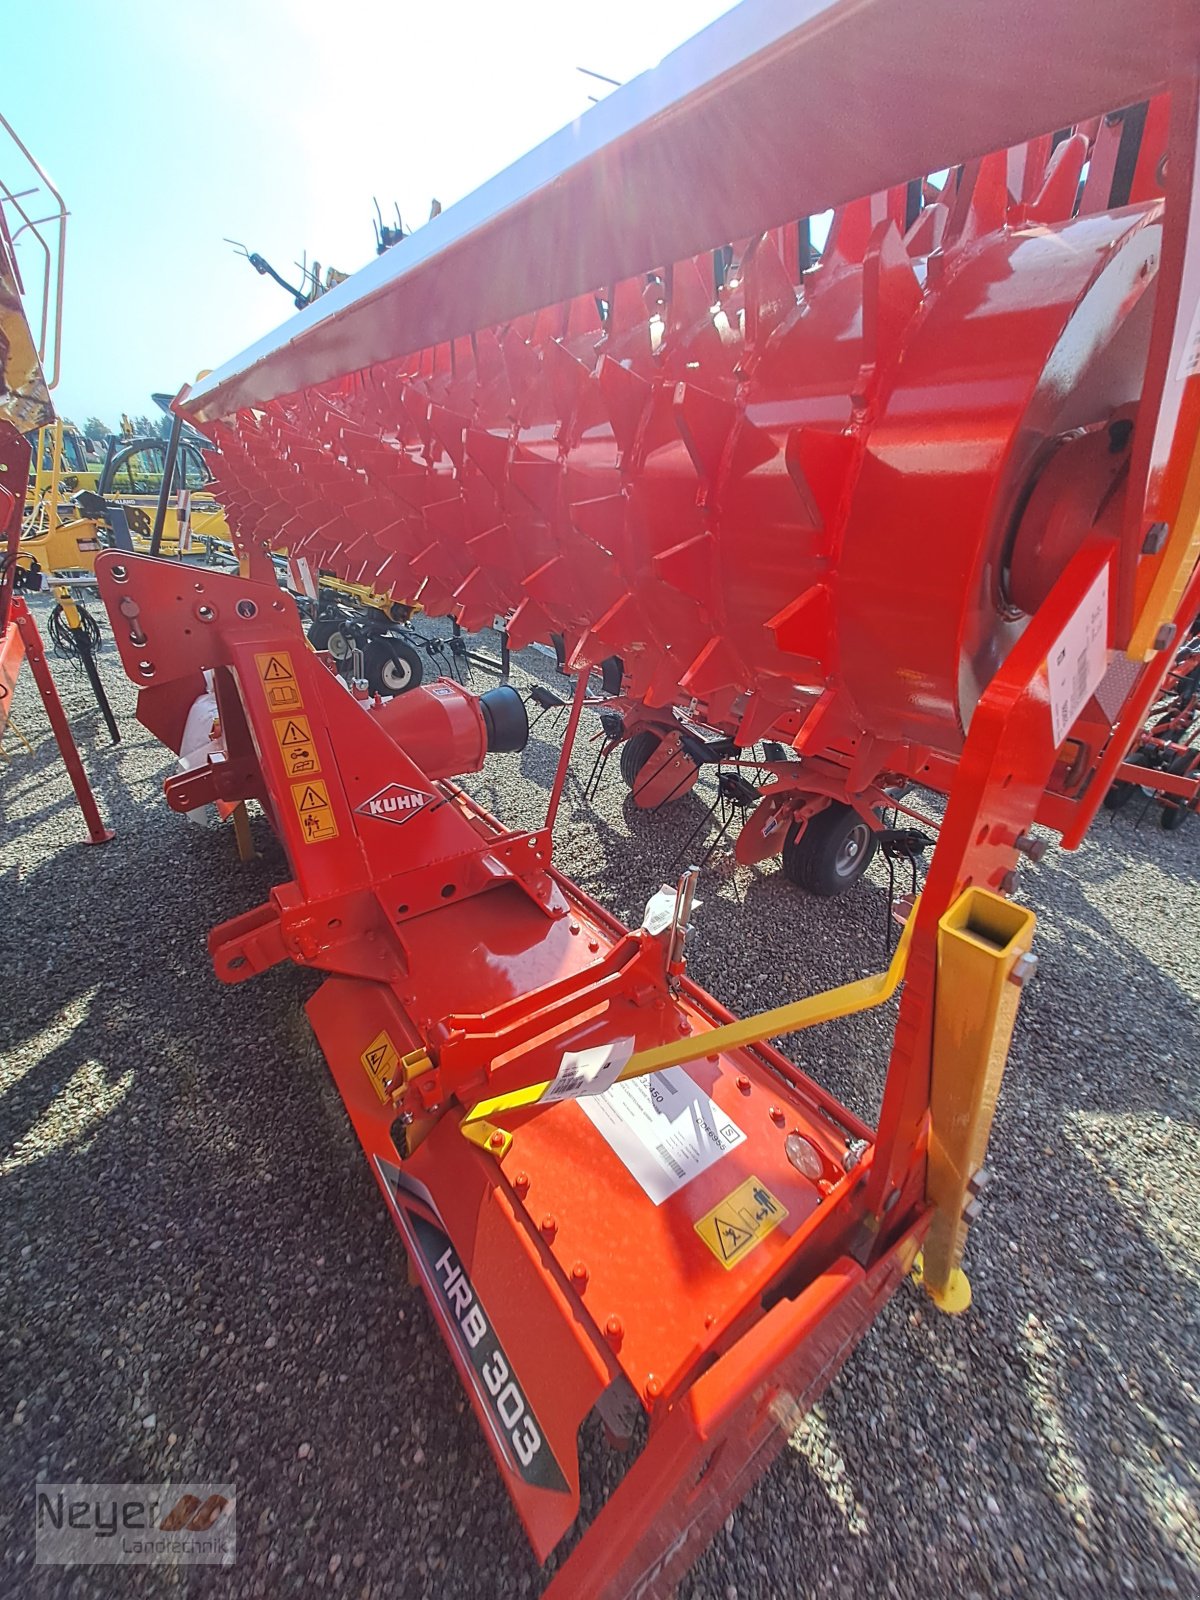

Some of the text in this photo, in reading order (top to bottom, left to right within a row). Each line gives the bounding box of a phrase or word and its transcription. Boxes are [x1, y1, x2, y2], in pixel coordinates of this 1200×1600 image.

[369, 793, 425, 815] KUHN
[725, 1128, 734, 1137] S
[435, 1246, 541, 1467] HRB 303
